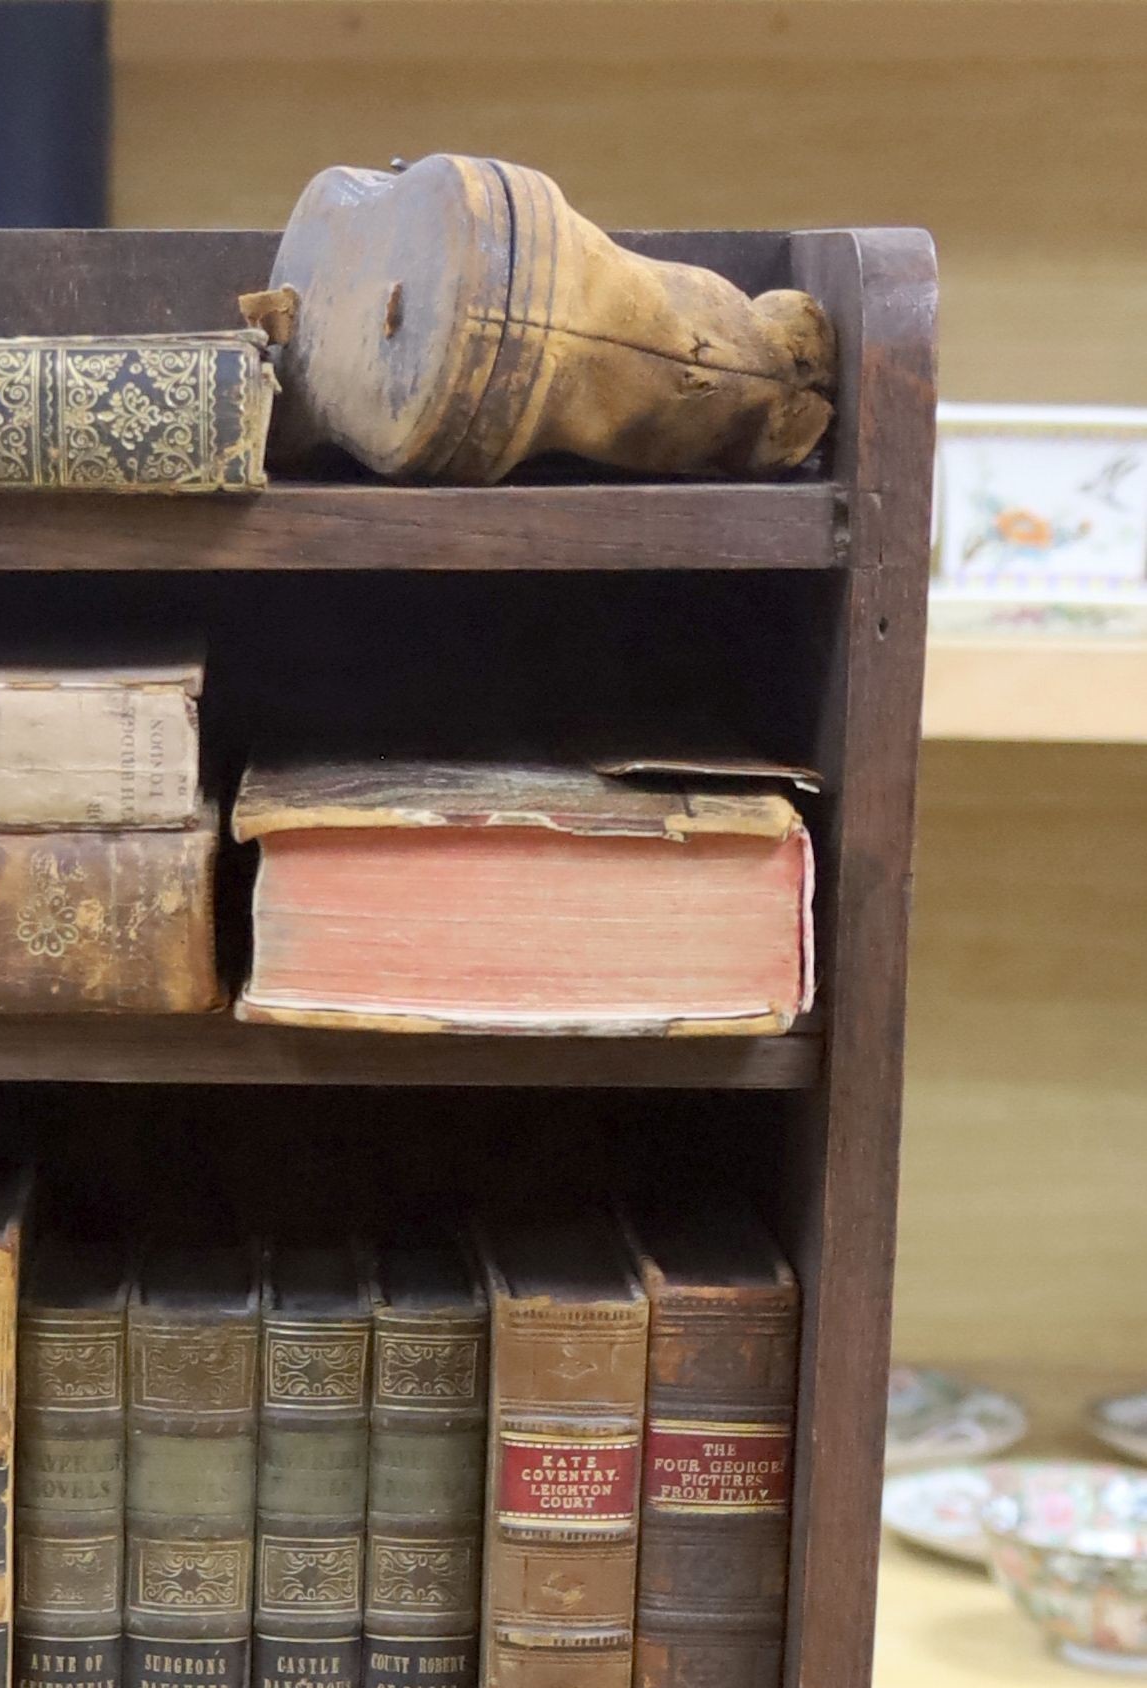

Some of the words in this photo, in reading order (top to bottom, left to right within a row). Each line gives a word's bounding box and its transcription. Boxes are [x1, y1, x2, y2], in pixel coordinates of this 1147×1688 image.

[703, 1443, 736, 1456] THE
[542, 1455, 598, 1468] KATE
[654, 1458, 700, 1473] FOUR
[681, 1473, 764, 1487] PICTURES
[530, 1483, 613, 1496] LEIGHTON
[660, 1485, 709, 1499] FROM
[719, 1488, 769, 1502] ITALY
[540, 1496, 595, 1509] COURT
[30, 1653, 77, 1673] ANNE
[85, 1654, 104, 1671] OF
[277, 1655, 341, 1675] CASTLE
[371, 1652, 410, 1674] COUNT
[418, 1655, 466, 1674] ROBERT
